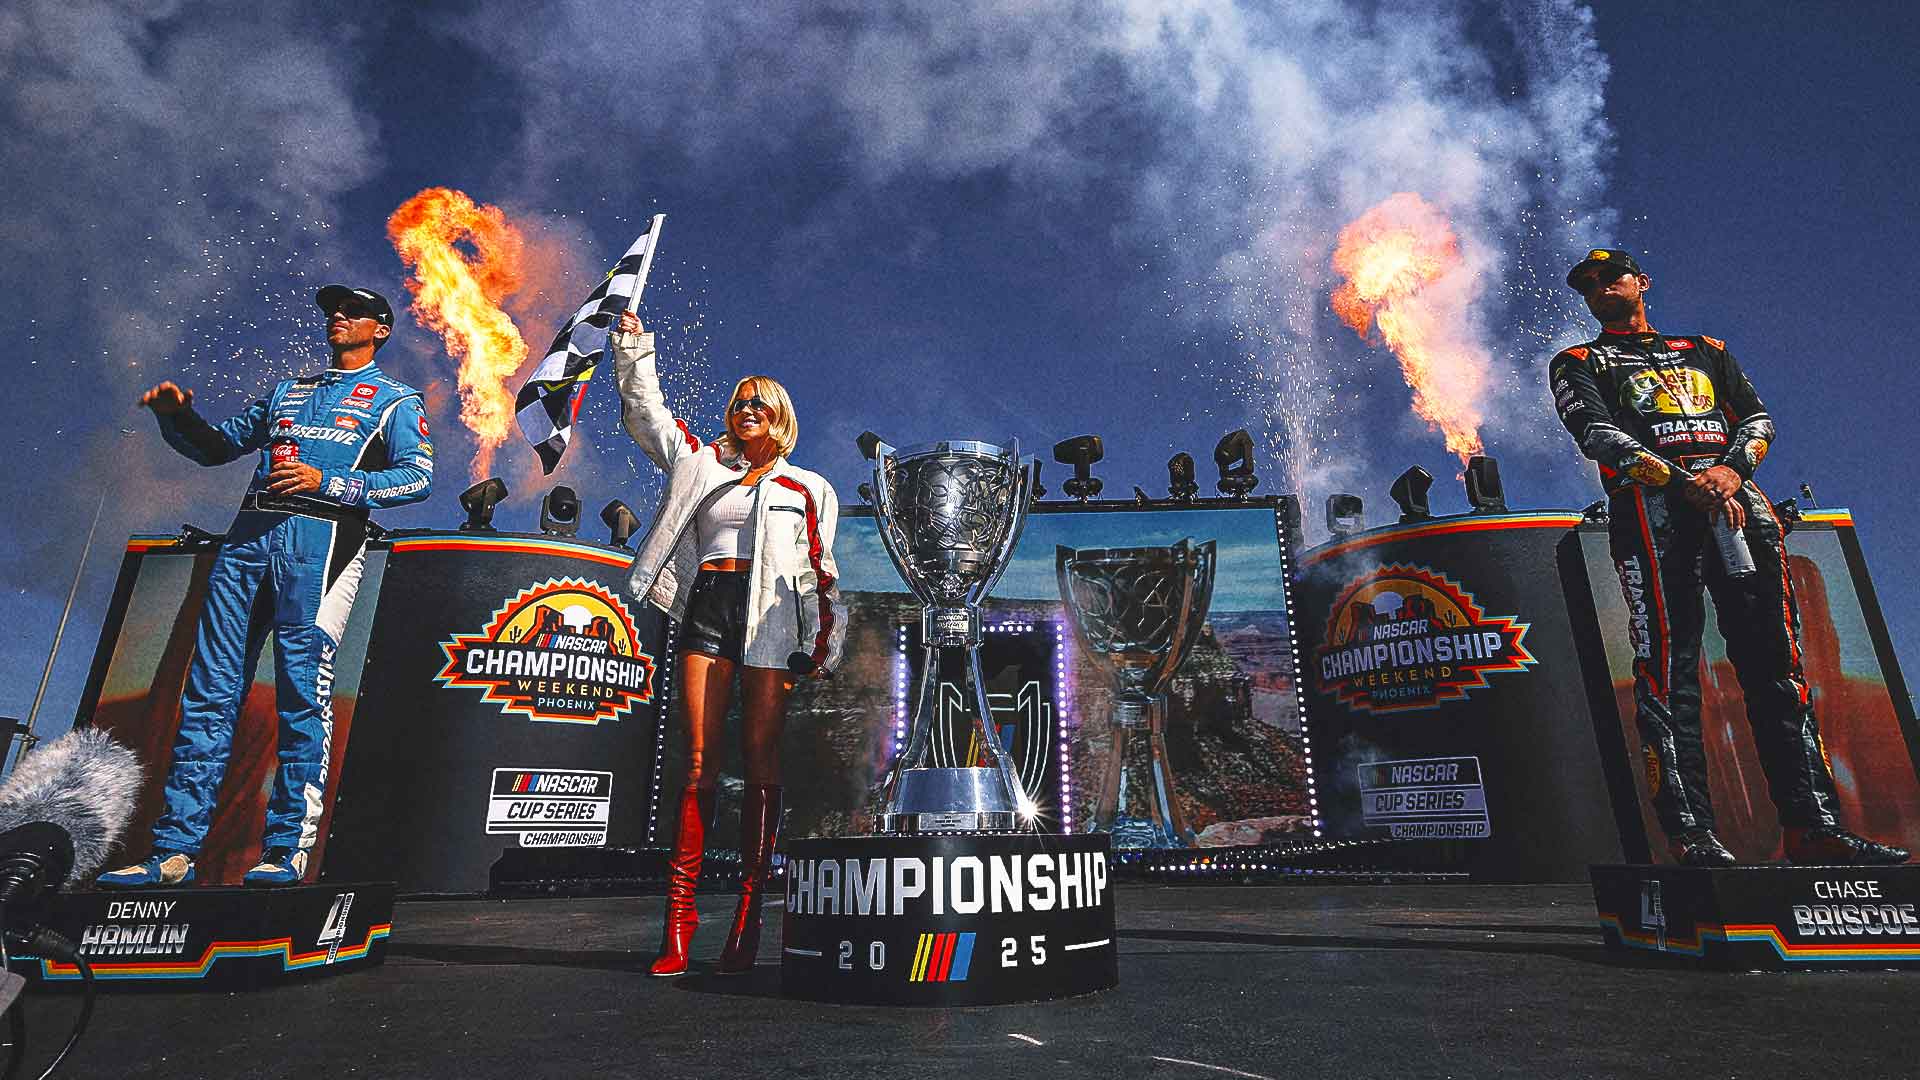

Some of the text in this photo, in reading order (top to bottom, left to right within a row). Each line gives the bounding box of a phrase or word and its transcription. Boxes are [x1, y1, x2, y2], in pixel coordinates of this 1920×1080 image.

[1651, 420, 1723, 436] TRACKER
[1373, 618, 1428, 640] NASCAR
[554, 635, 607, 654] NASCAR
[1322, 632, 1502, 680] CHAMPIONSHIP
[466, 648, 645, 689] CHAMPIONSHIP
[1352, 666, 1452, 688] WEEKEND
[517, 680, 614, 699] WEEKEND
[1371, 686, 1432, 698] PHOENIX
[537, 697, 596, 711] PHOENIX
[1391, 763, 1459, 783] NASCAR
[535, 774, 599, 793] NASCAR
[507, 802, 597, 819] CUP SERIES
[1375, 791, 1465, 811] CUP SERIES
[523, 832, 604, 845] CHAMPIONSHIP
[1394, 822, 1485, 837] CHAMPIONSHIP
[786, 852, 1107, 915] CHAMPIONSHIP
[1813, 881, 1882, 898] CHASE
[107, 900, 177, 919] DENNY
[1792, 904, 1920, 936] BRISCOE
[79, 923, 190, 955] HAMLIN
